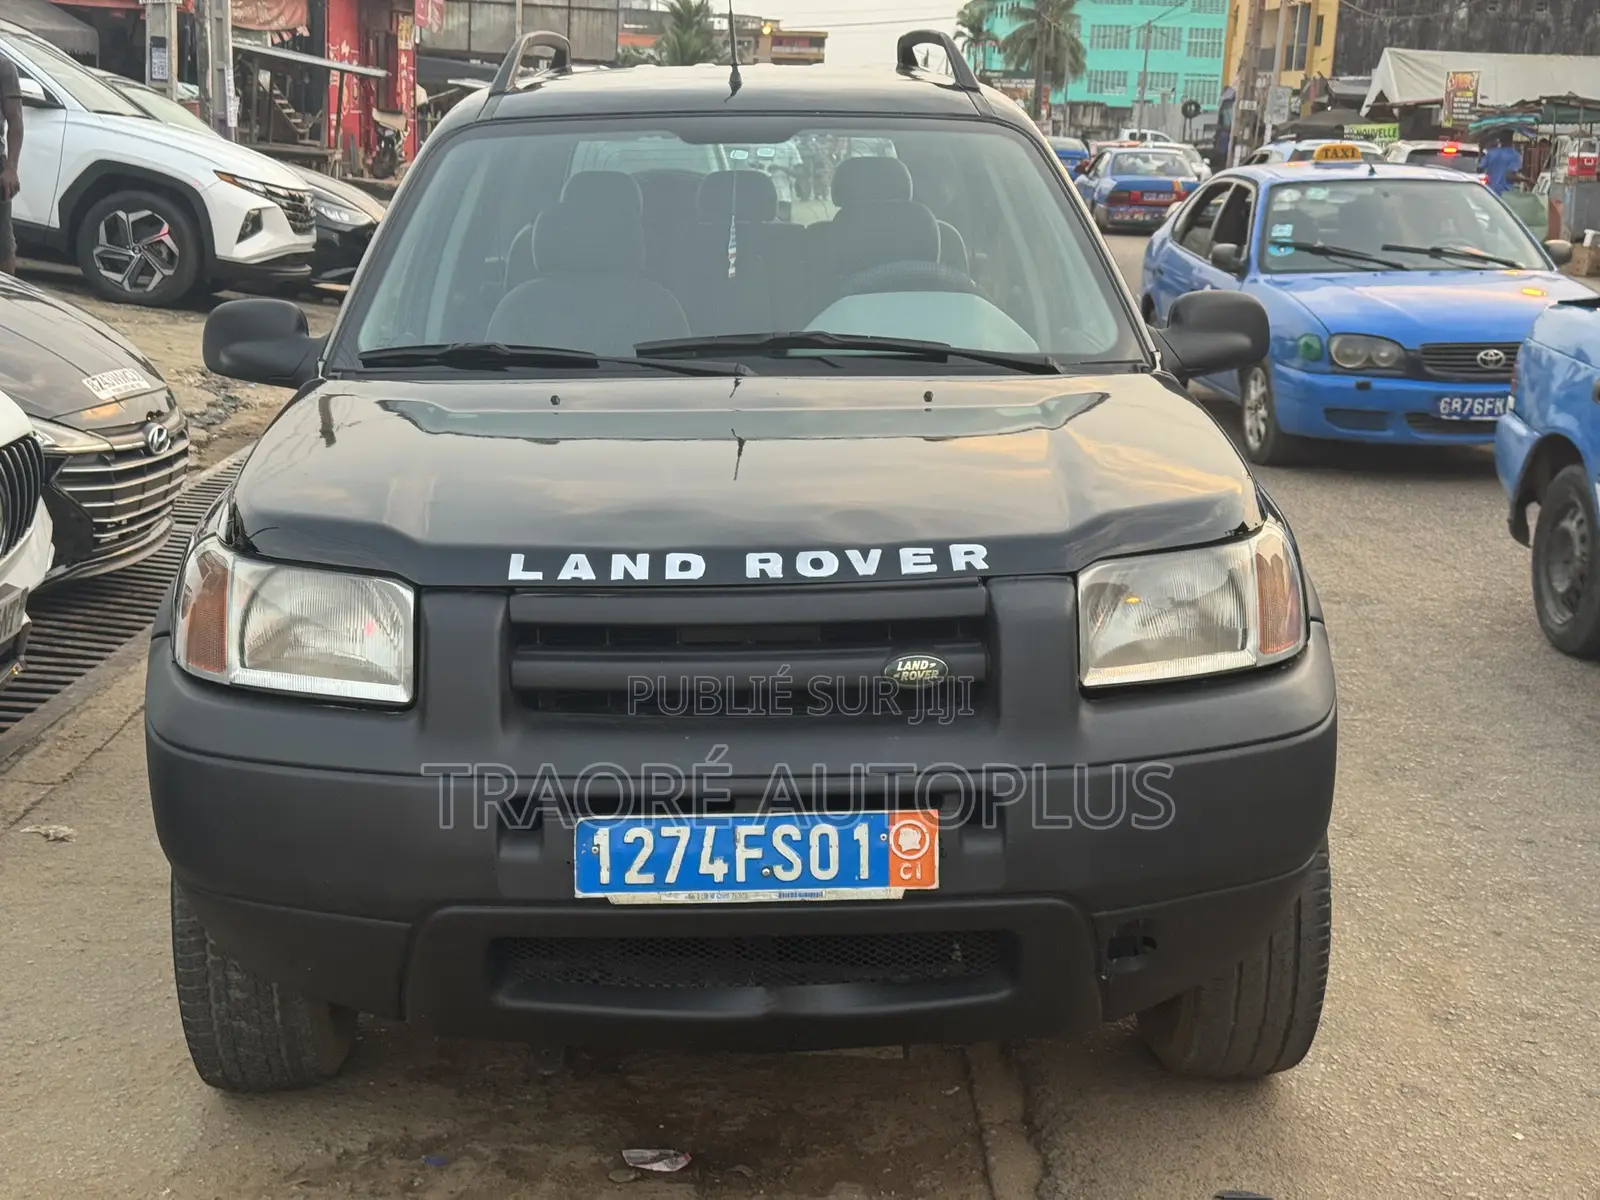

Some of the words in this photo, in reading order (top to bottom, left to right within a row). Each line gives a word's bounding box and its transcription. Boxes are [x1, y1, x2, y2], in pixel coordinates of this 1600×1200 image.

[1323, 148, 1356, 159] TAXI
[508, 552, 706, 581] LAND
[745, 543, 989, 579] ROVER
[897, 660, 929, 671] LAND
[901, 670, 940, 681] ROVER
[593, 822, 869, 885] 1274FS01
[899, 861, 922, 880] CI
